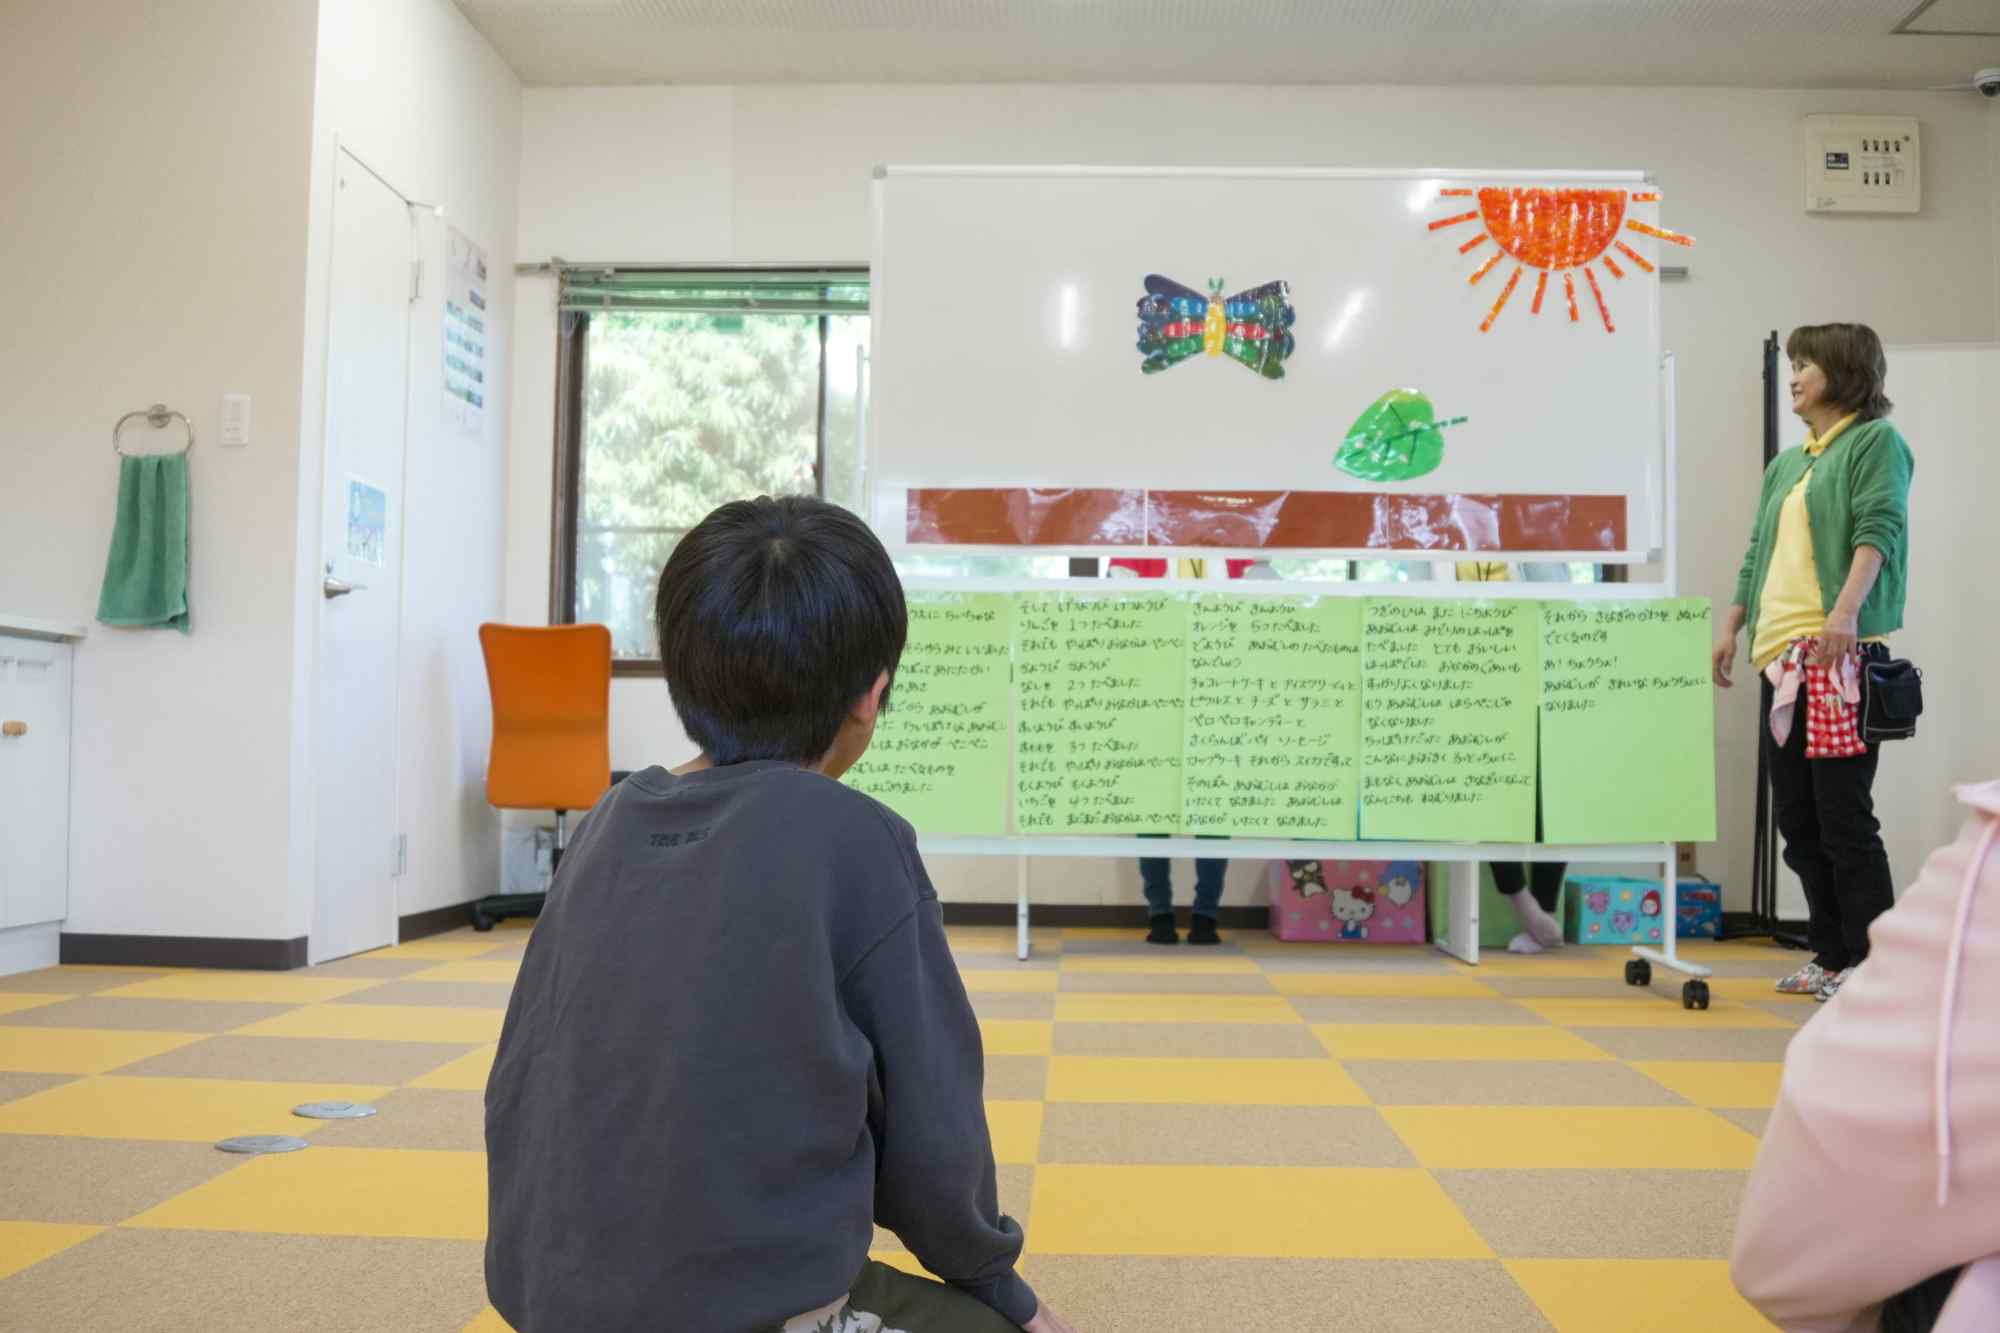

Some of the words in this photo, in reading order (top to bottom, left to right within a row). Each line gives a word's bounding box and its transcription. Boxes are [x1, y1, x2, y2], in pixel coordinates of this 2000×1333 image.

[1019, 601, 1048, 614] そして
[1369, 603, 1426, 618] つぎのひは
[1431, 606, 1454, 620] また
[1460, 606, 1517, 618] にちようび
[1543, 609, 1588, 624] それから
[1019, 618, 1058, 631] りんごを
[1192, 618, 1237, 632] オレンジを
[1365, 622, 1418, 635] あおむしは
[1019, 637, 1057, 652] それでも
[1192, 637, 1234, 652] どようび
[1366, 640, 1418, 653] たべました
[1432, 643, 1461, 654] とても
[1019, 681, 1051, 693] なしを
[1191, 677, 1263, 690] チョコレートケーキ
[1543, 675, 1600, 693] あおむしが
[928, 702, 987, 716] あおむしが
[1019, 696, 1055, 711] それでも
[1385, 698, 1442, 710] あおむしは
[1017, 718, 1064, 733] すいようび
[1067, 717, 1116, 731] すいようび
[1278, 734, 1331, 746] ソーセージ
[1447, 733, 1510, 745] あおむしが
[1018, 741, 1054, 753] すももを
[1019, 758, 1056, 773] それでも
[1249, 755, 1290, 766] それから
[1017, 776, 1064, 792] もくようび
[1070, 775, 1120, 790] もくようび
[1232, 779, 1289, 792] あおむしは
[1018, 794, 1056, 808] いちごを
[1228, 796, 1275, 807] なきました
[1284, 796, 1341, 807] あおむしは
[1019, 813, 1053, 826] それでも
[1184, 812, 1227, 826] おなかが
[1275, 816, 1327, 828] なきました
